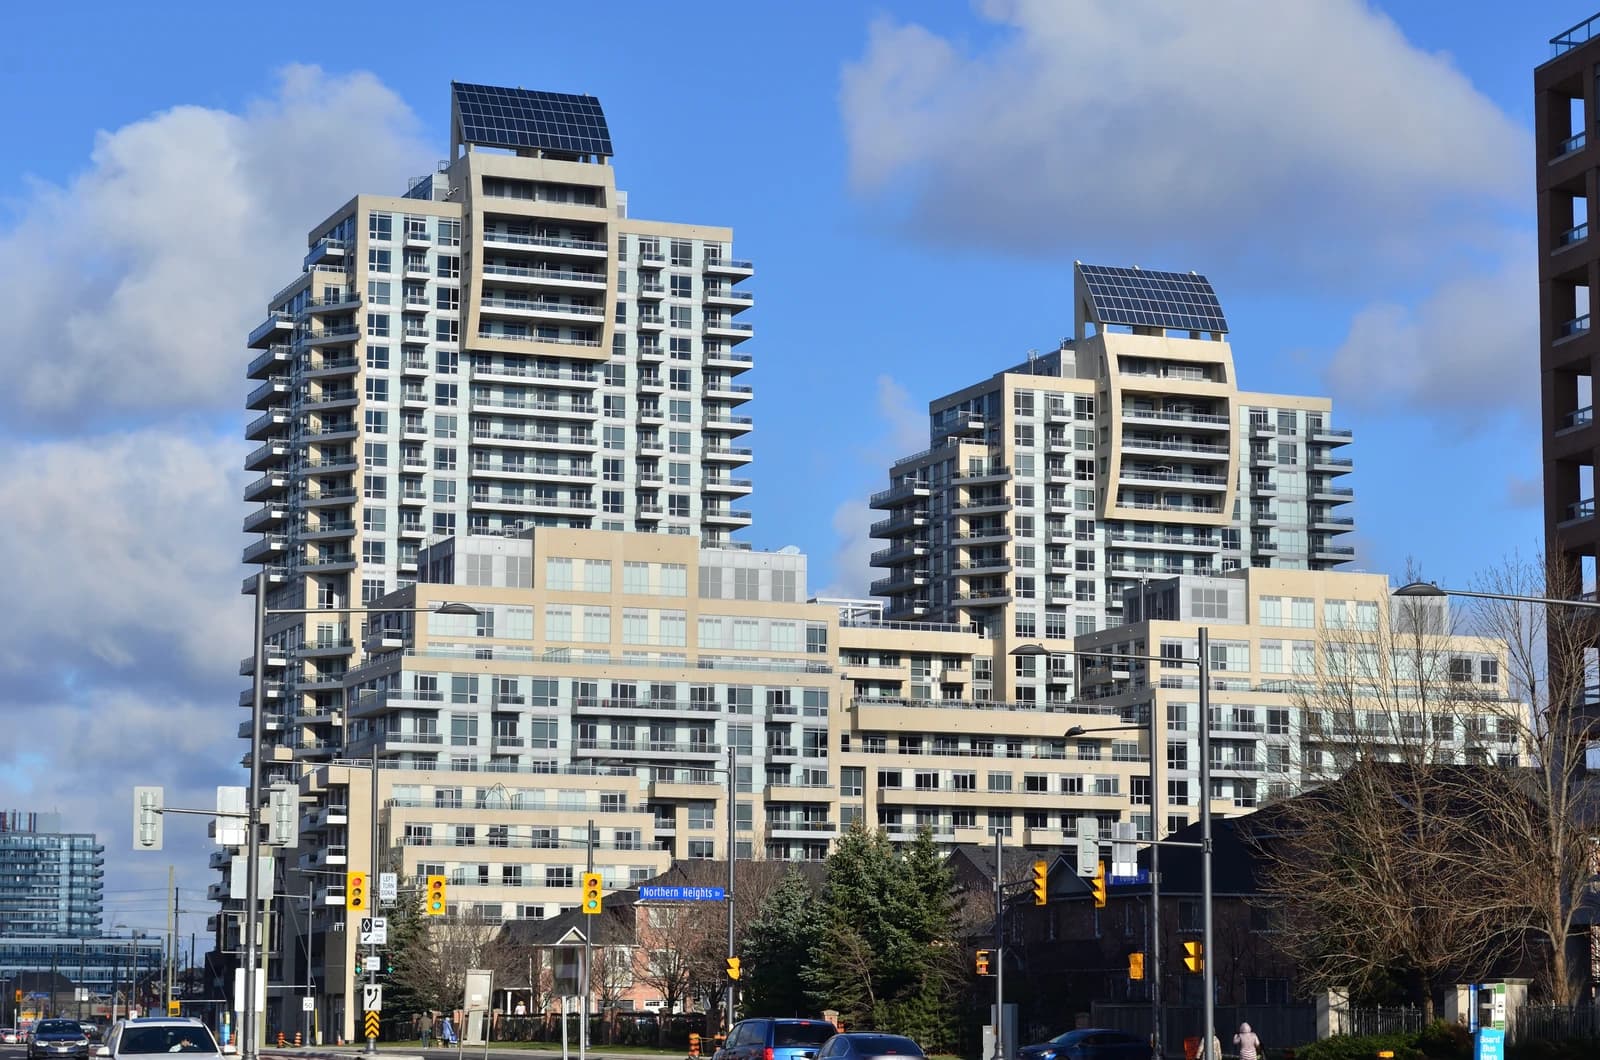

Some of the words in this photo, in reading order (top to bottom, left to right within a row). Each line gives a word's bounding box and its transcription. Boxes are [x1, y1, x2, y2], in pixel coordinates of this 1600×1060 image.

[643, 887, 679, 897] Northern
[682, 887, 713, 900] Heights
[1480, 1036, 1500, 1044] Board
[1482, 1045, 1496, 1053] Bus
